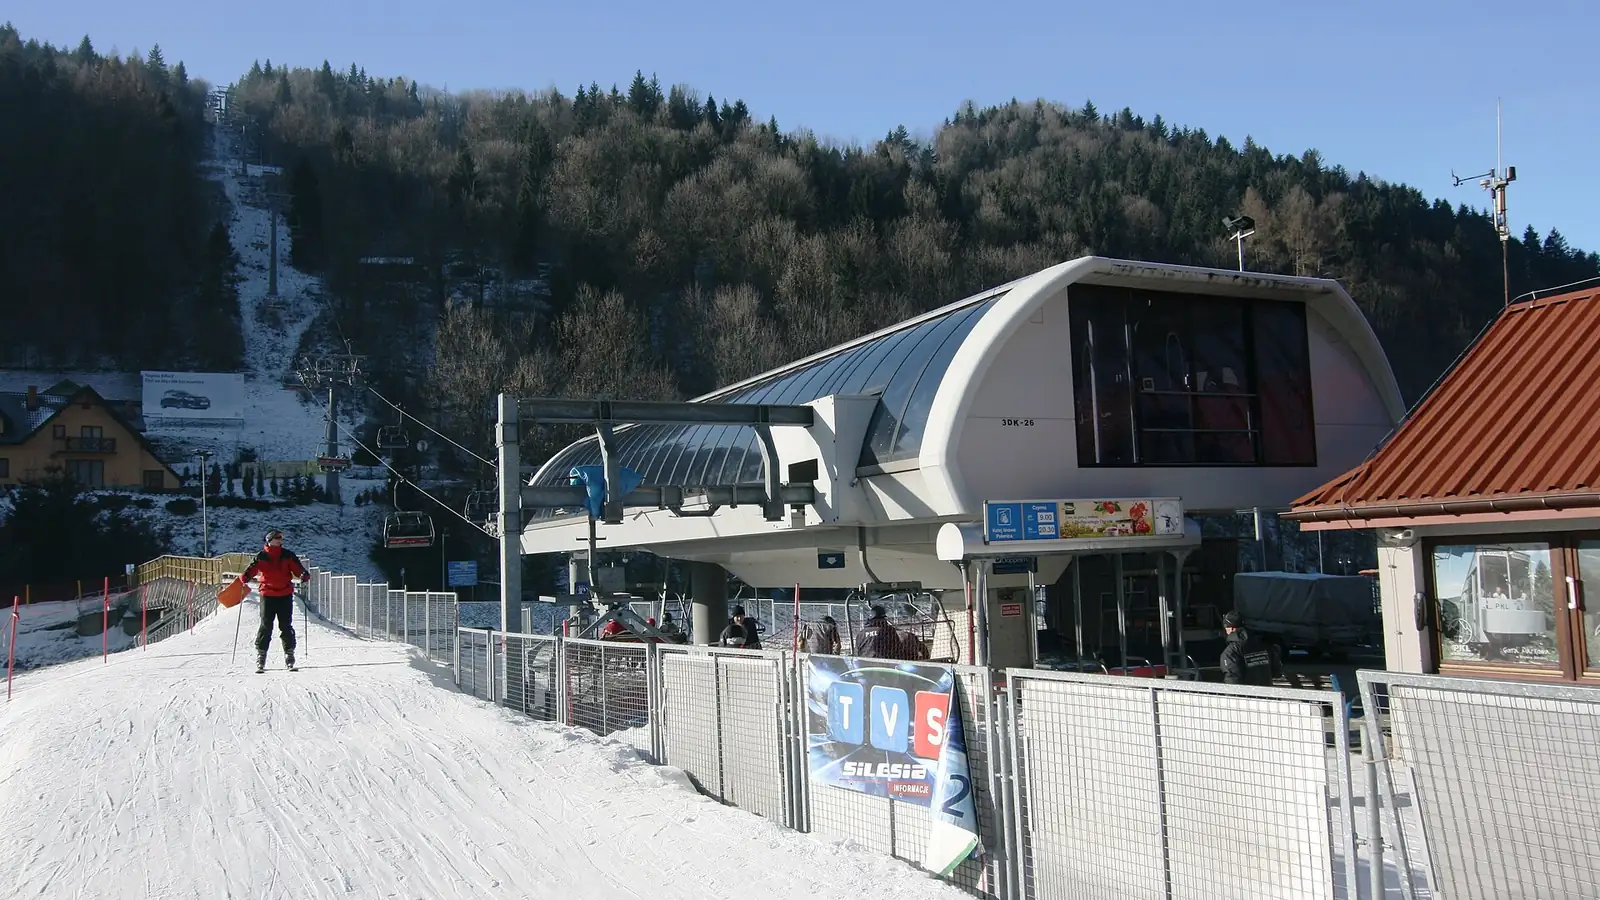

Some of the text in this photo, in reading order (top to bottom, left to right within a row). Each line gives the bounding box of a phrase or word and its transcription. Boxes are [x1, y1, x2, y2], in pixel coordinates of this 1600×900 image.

[1001, 419, 1035, 427] 3DK-26
[1495, 602, 1510, 610] PKL
[865, 630, 878, 638] PKL
[1451, 644, 1471, 652] PKL
[893, 784, 929, 794] INFORMACJE
